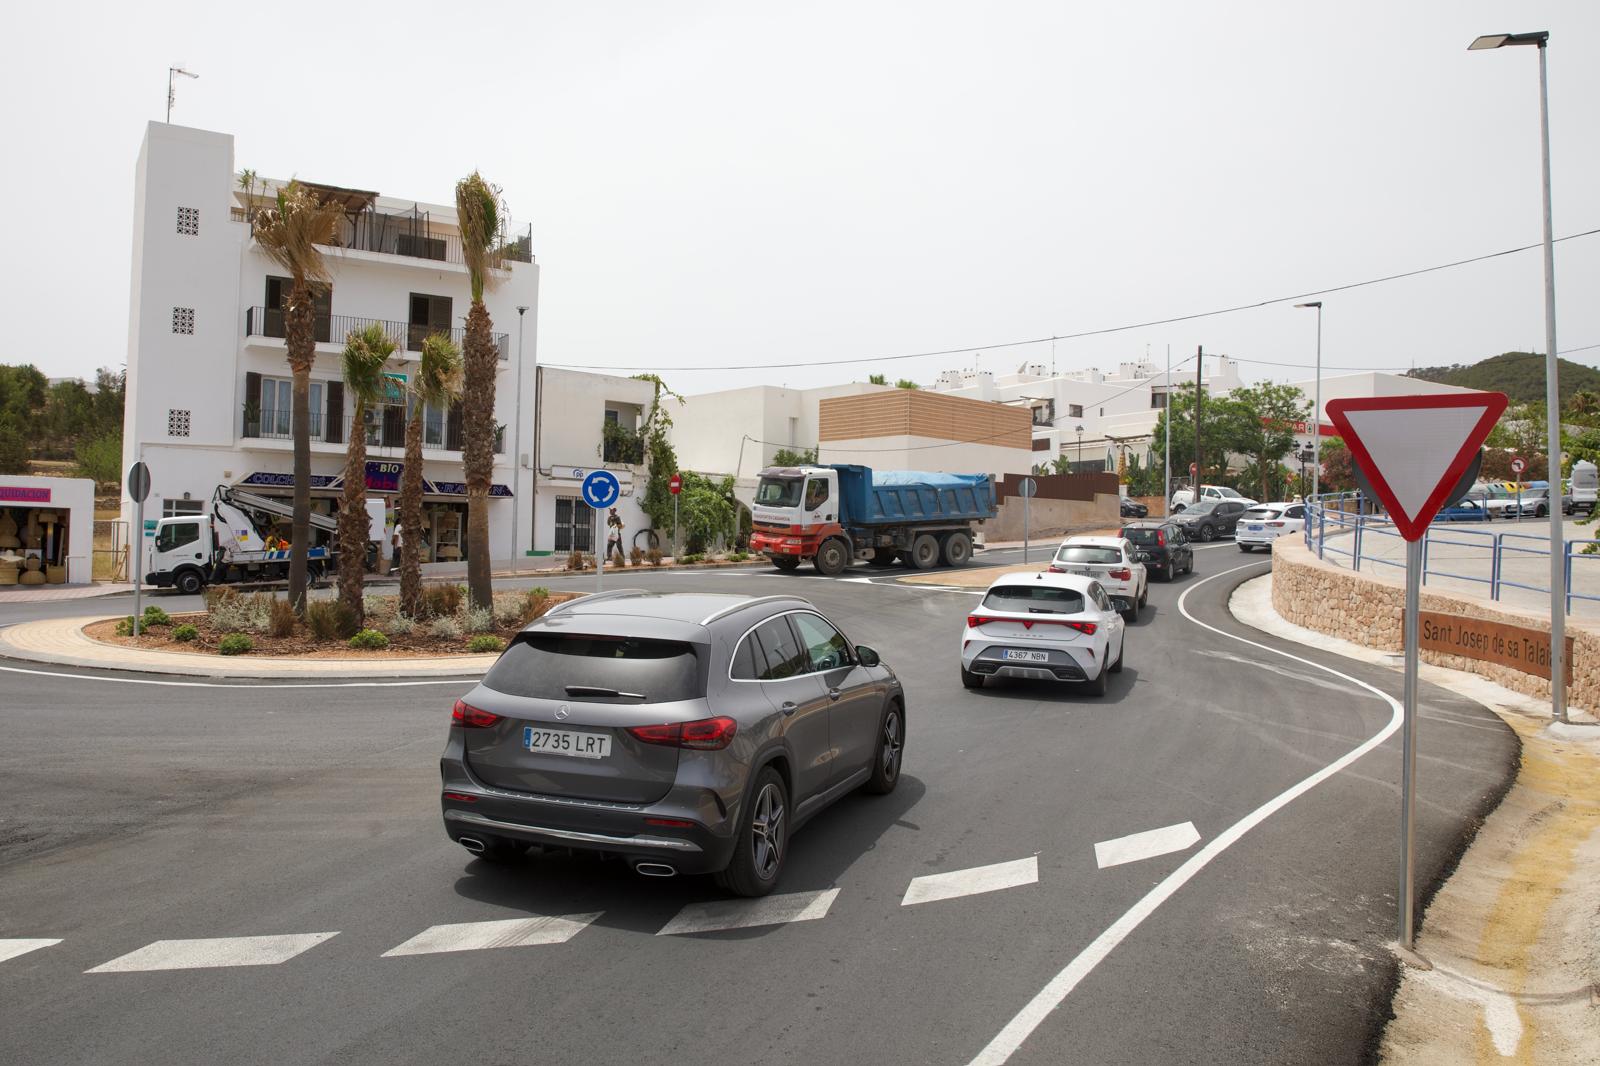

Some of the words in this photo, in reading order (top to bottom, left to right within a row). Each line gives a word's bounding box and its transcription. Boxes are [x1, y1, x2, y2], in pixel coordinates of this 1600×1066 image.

[380, 464, 399, 474] BIO
[1423, 620, 1452, 644] Sant
[1456, 625, 1489, 653] Josep
[1492, 632, 1504, 655] de
[1507, 639, 1519, 659] sa
[1522, 638, 1552, 668] Talai
[532, 731, 570, 750] 2735
[575, 735, 606, 753] LRT
